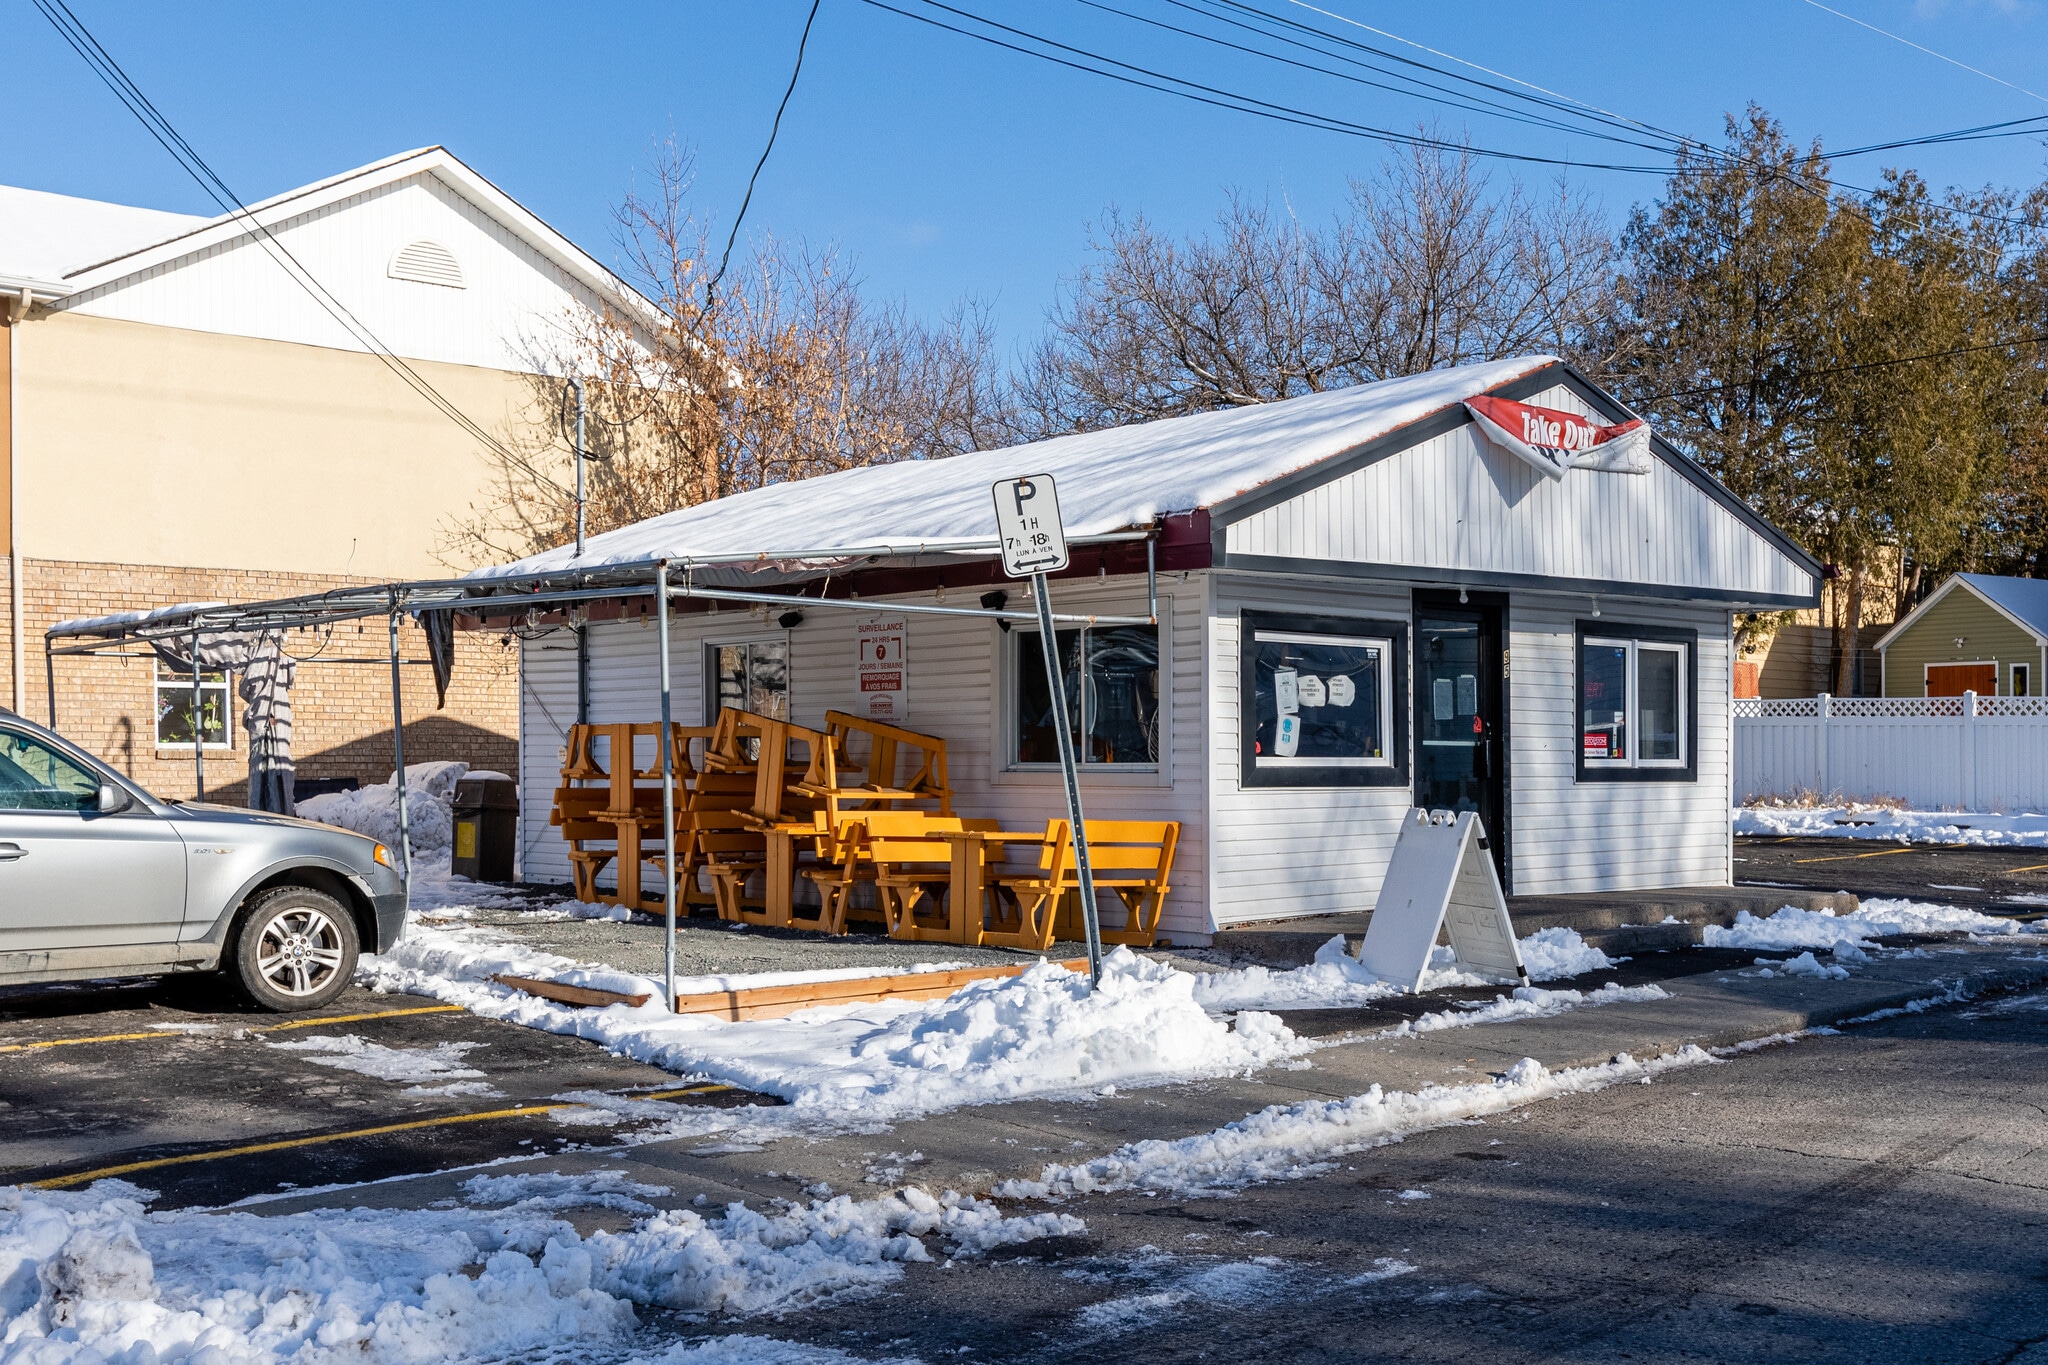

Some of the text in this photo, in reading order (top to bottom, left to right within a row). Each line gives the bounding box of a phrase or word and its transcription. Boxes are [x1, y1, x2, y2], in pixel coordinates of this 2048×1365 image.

[1521, 411, 1597, 450] Take Out
[1013, 481, 1037, 516] P
[1020, 517, 1039, 531] 1 H
[1016, 549, 1030, 557] LUN
[858, 623, 903, 633] SURVEILLANCE
[878, 647, 883, 657] 7
[858, 663, 876, 671] JOURS
[862, 673, 900, 681] REMORQUAGE
[881, 682, 897, 690] FRAIS
